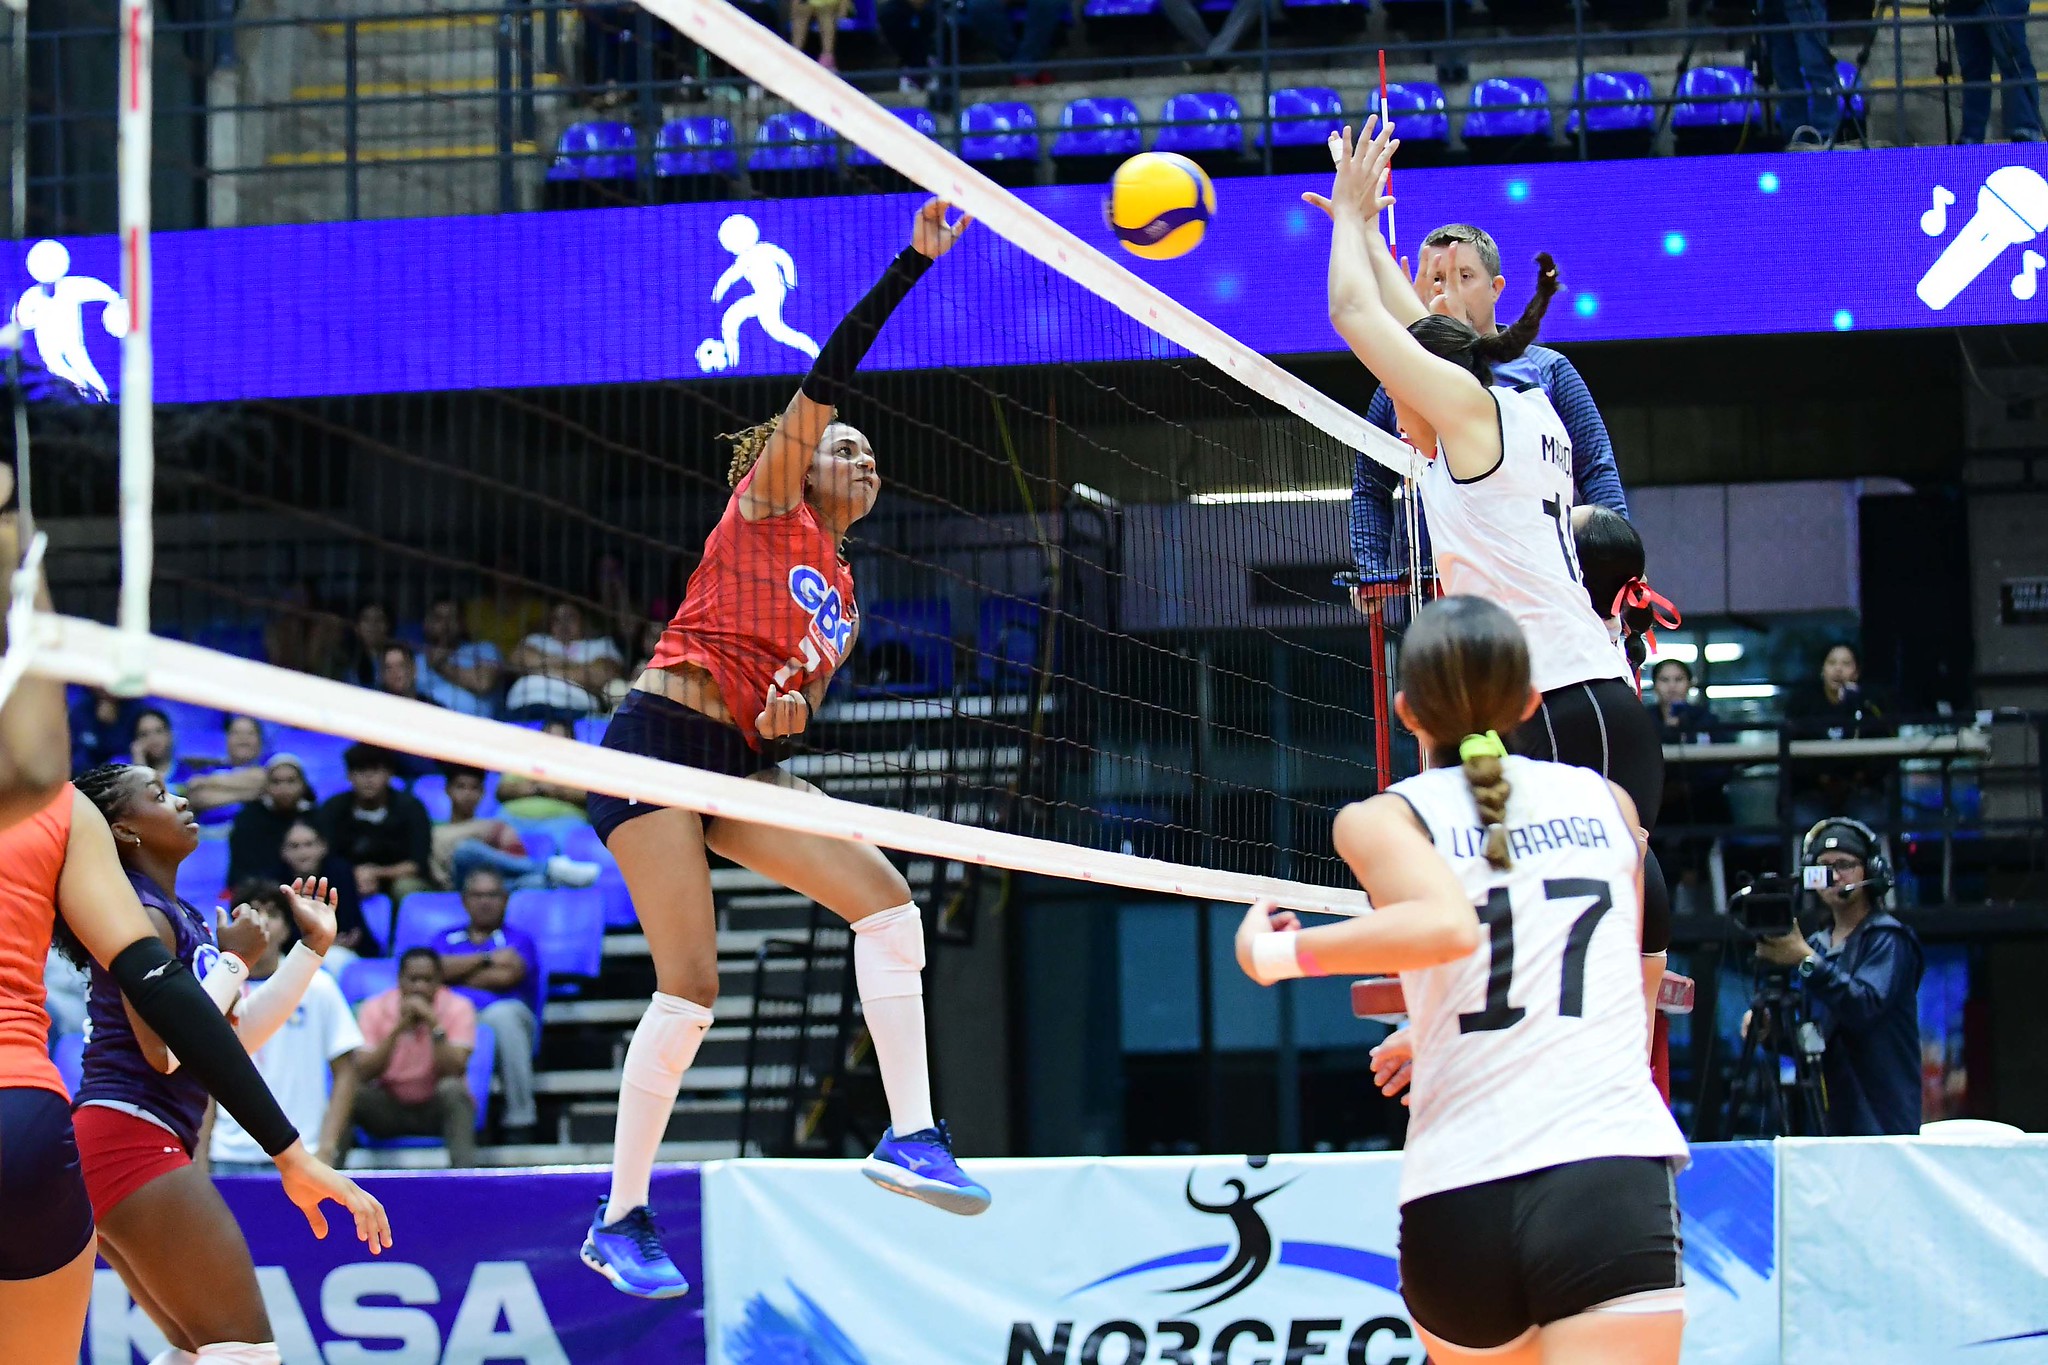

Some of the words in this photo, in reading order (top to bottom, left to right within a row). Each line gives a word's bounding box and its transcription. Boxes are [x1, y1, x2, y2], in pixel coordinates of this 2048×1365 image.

[1451, 816, 1609, 859] LIZRRAGA
[1457, 876, 1612, 1034] 17
[1004, 1317, 1431, 1365] NORCEC
